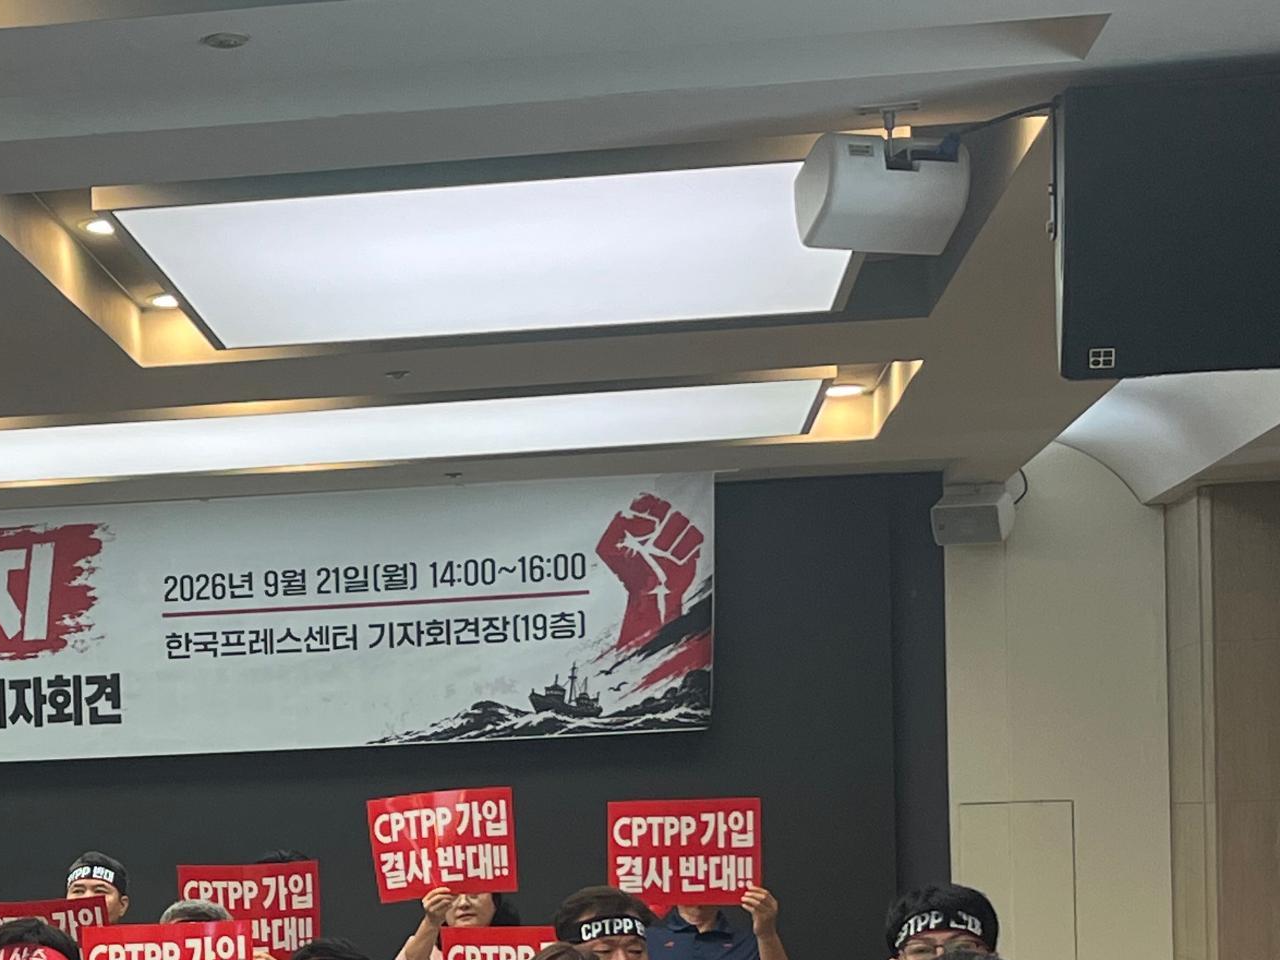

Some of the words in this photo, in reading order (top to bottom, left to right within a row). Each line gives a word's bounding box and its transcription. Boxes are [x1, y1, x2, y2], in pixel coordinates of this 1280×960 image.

[163, 572, 255, 603] 2026년
[263, 567, 308, 599] 9월
[429, 553, 587, 588] 14:00~16:00
[164, 622, 358, 660] 한국프레스센터
[374, 810, 452, 844] CPTPP
[456, 800, 508, 838] 가입
[612, 816, 696, 848] CPTPP
[700, 810, 754, 848] 가입
[380, 848, 433, 889] 결사
[437, 843, 509, 882] 반대!!
[615, 856, 673, 893] 결사
[679, 855, 753, 892] 반대!!
[183, 880, 258, 909] CPTPP
[262, 873, 313, 910] 가입
[581, 918, 632, 940] CPTPP
